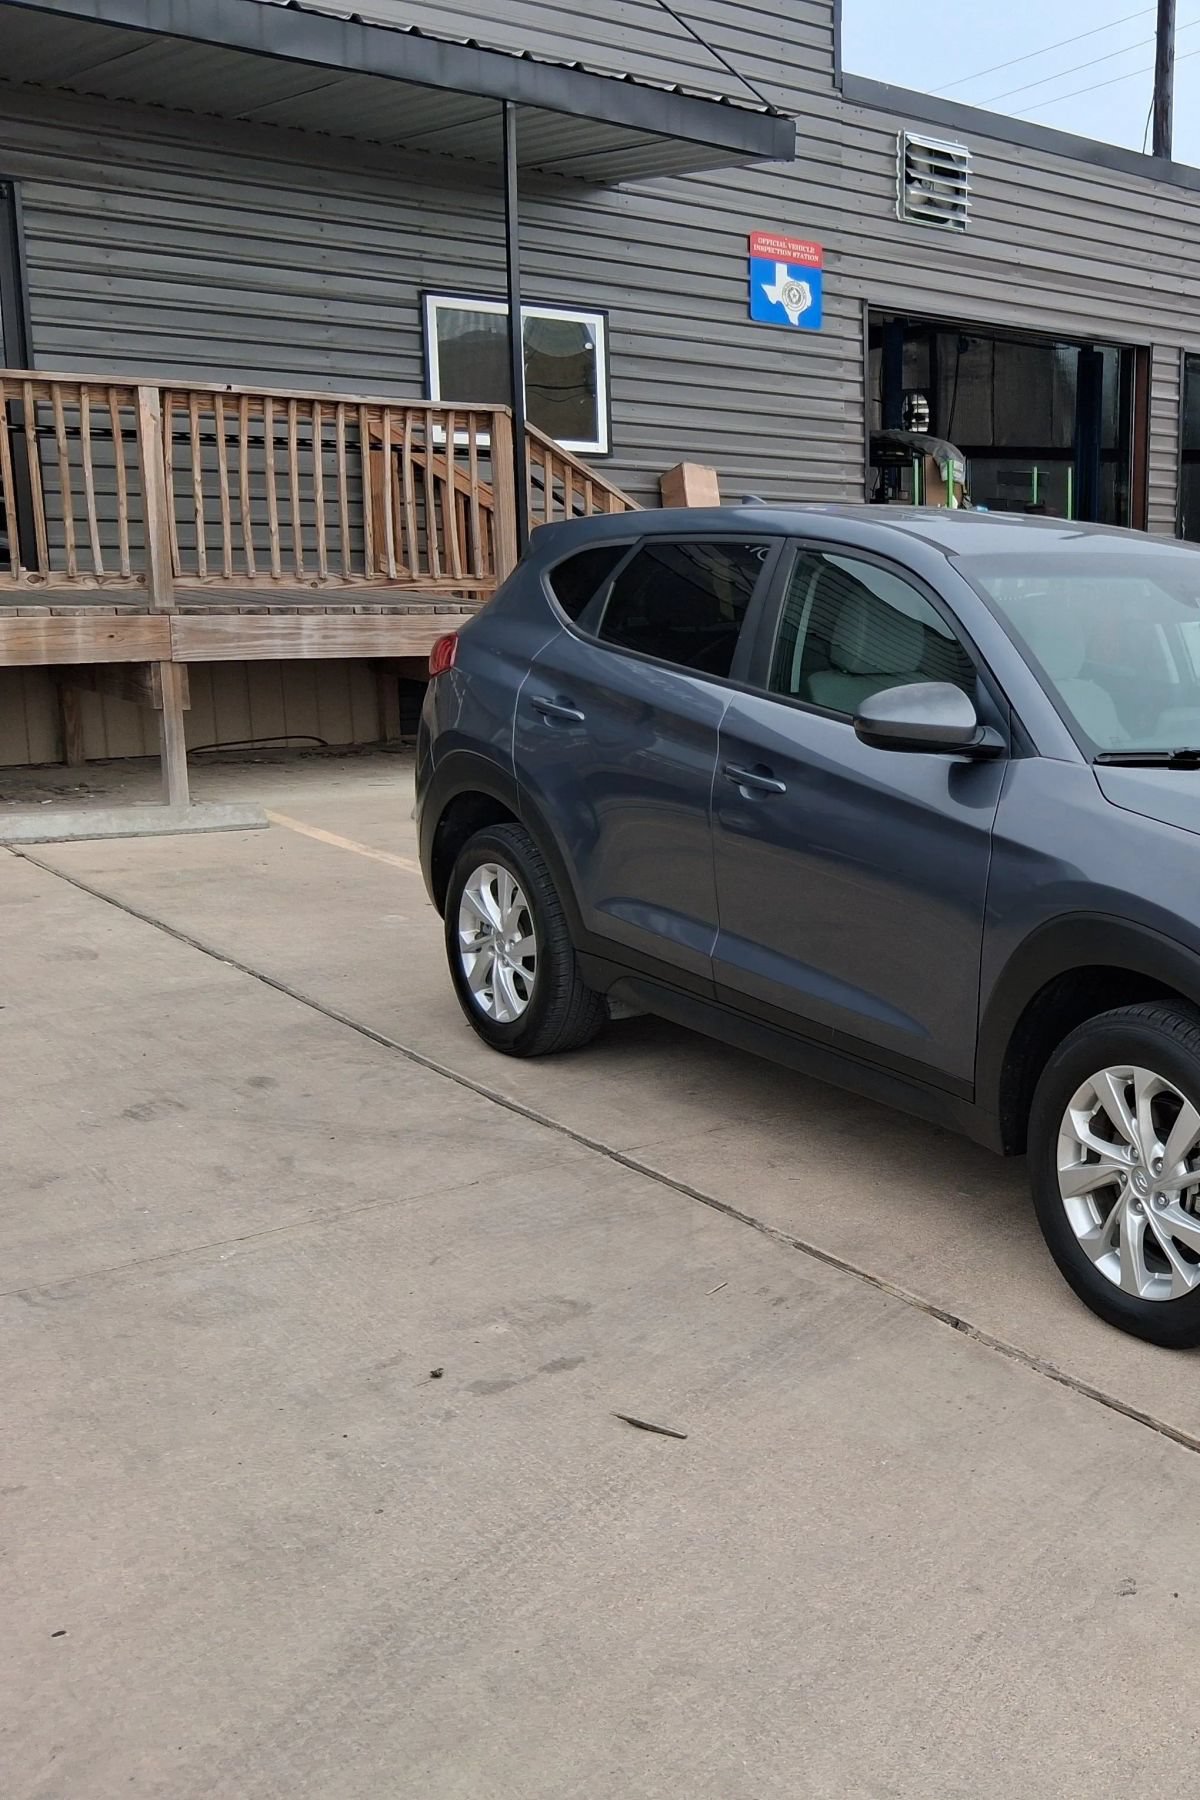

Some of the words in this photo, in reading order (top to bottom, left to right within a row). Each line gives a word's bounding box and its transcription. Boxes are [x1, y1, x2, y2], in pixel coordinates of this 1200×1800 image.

[753, 244, 792, 257] INSPECTION
[792, 252, 819, 262] STATION
[757, 237, 787, 249] OFFICIAL
[788, 243, 815, 254] VEHICLE
